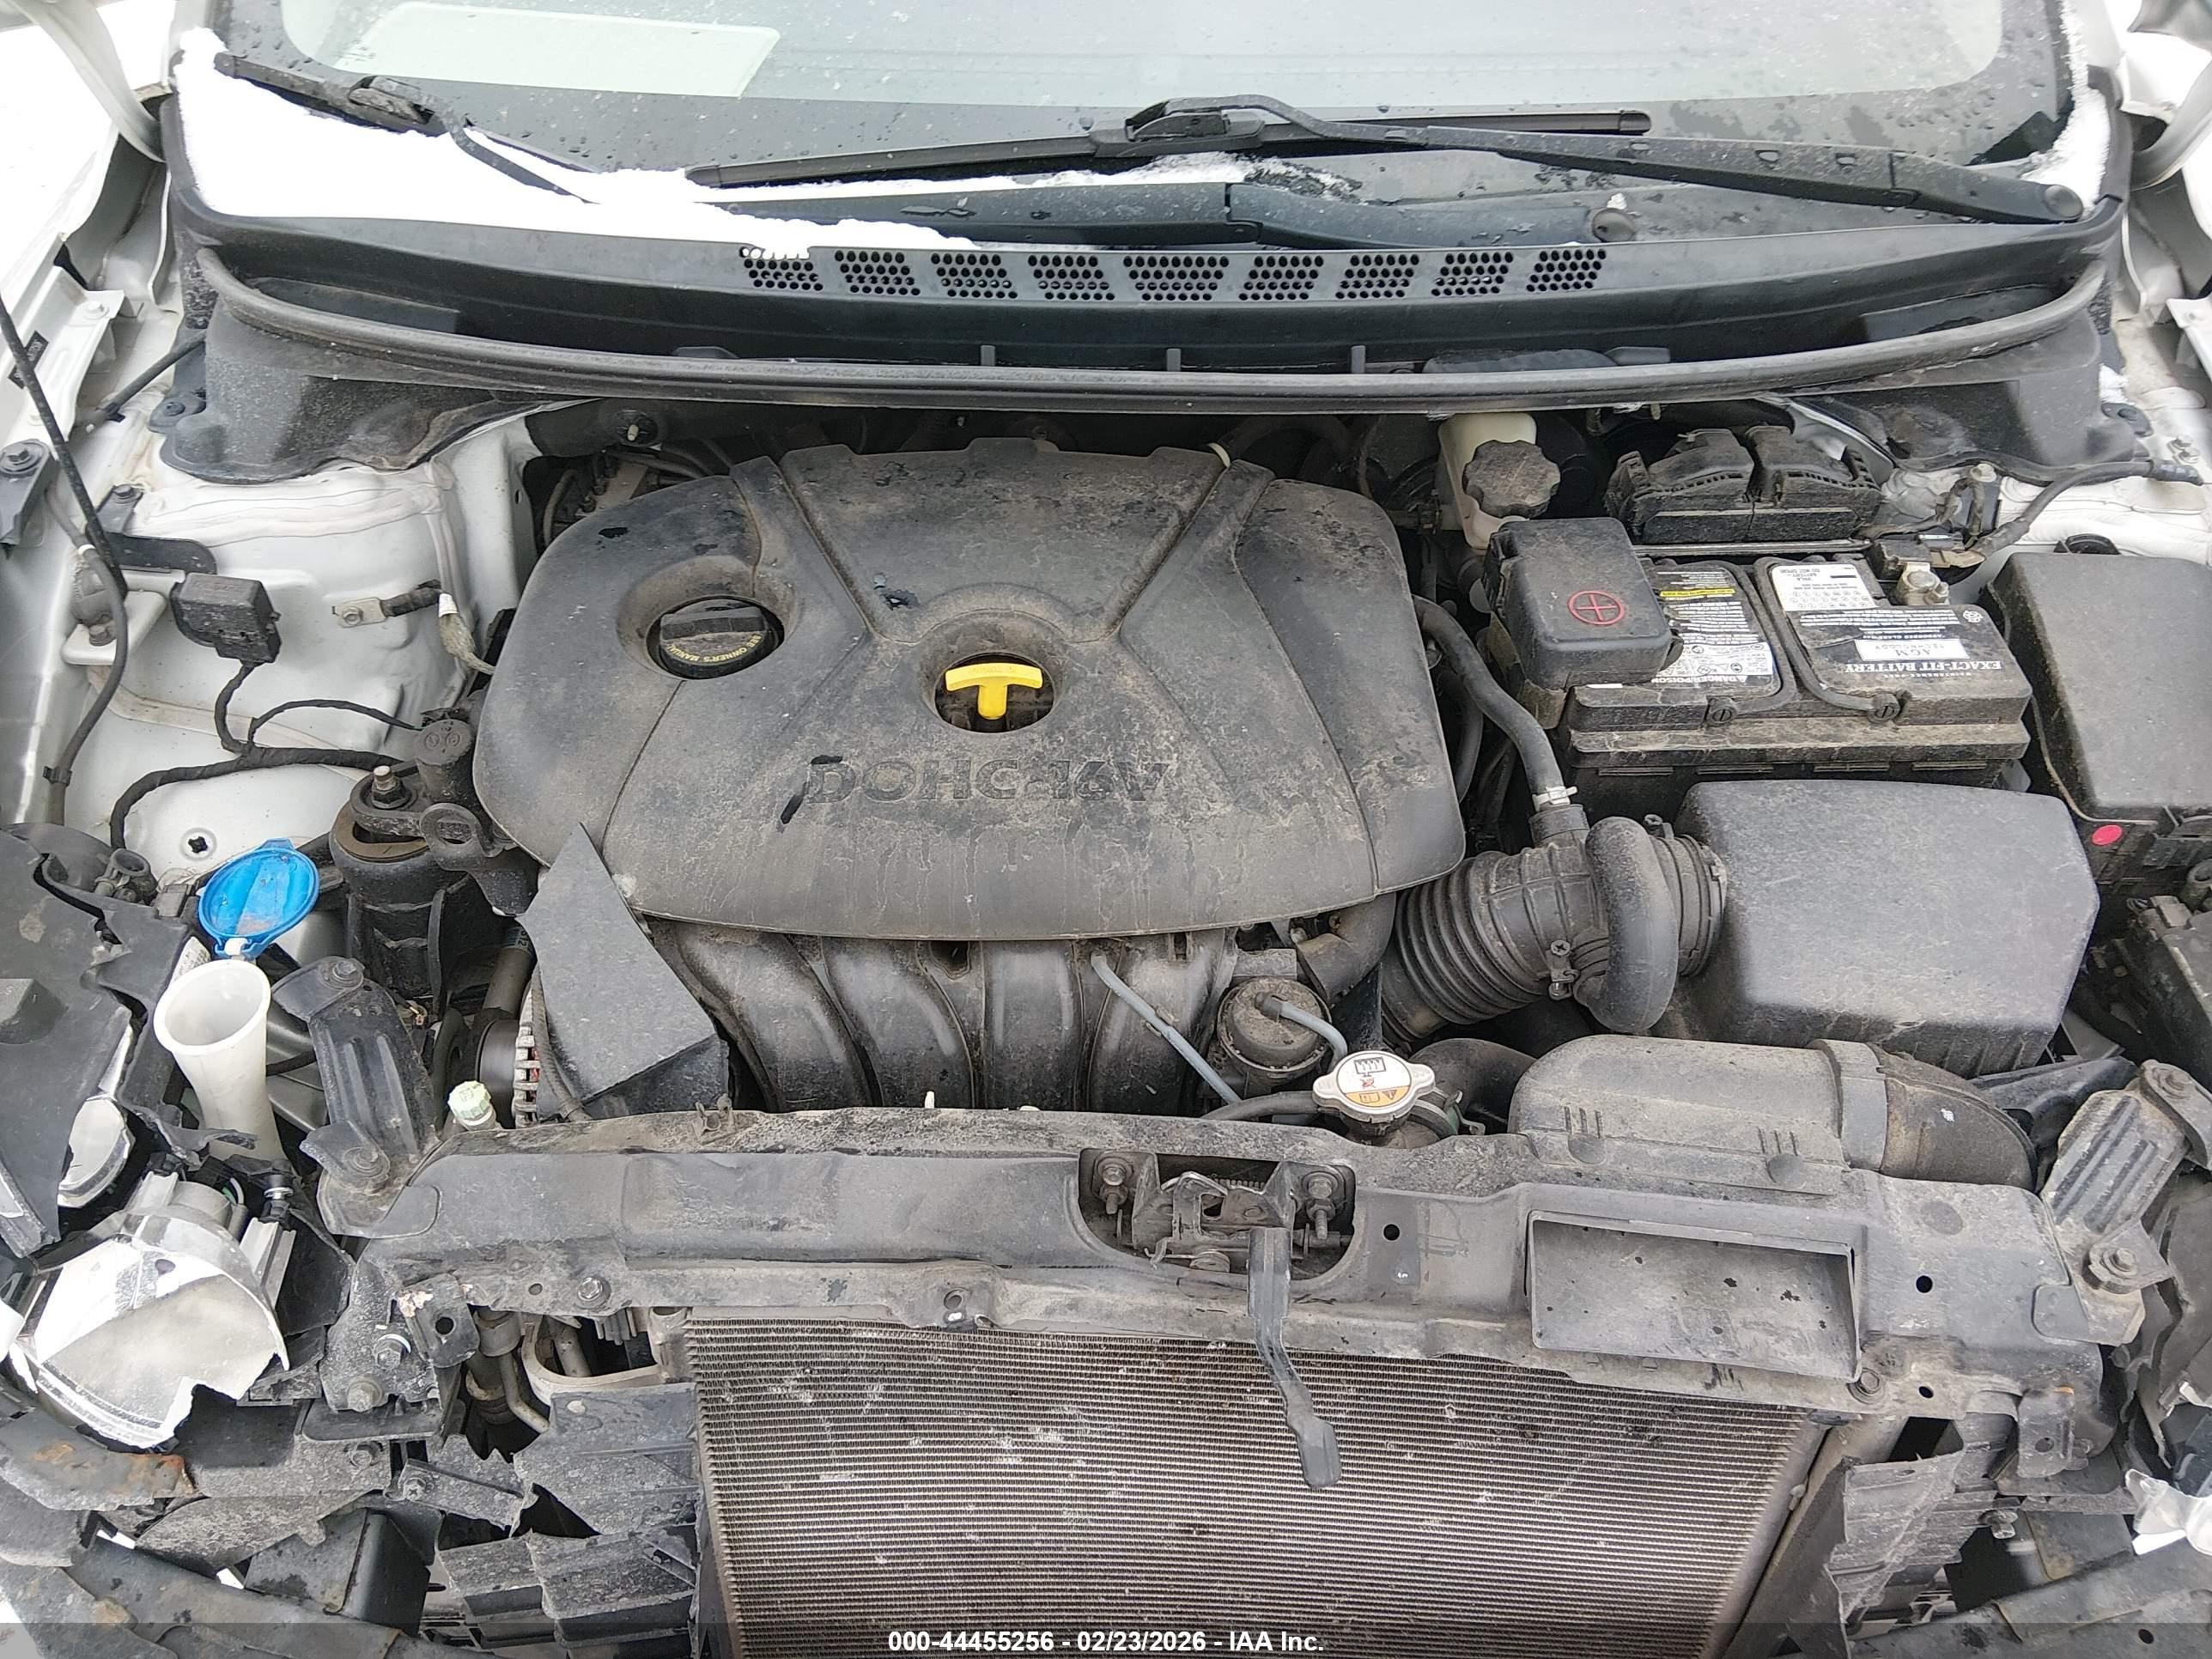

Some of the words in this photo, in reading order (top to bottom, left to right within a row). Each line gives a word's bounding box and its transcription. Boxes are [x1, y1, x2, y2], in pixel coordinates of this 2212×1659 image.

[747, 634, 763, 647] SEE
[1894, 648, 1931, 658] AGM
[1843, 662, 1915, 673] BATTERY
[1916, 660, 2002, 672] EXACT-FIT
[806, 758, 1020, 804] DOHC
[1048, 759, 1171, 801] 16V
